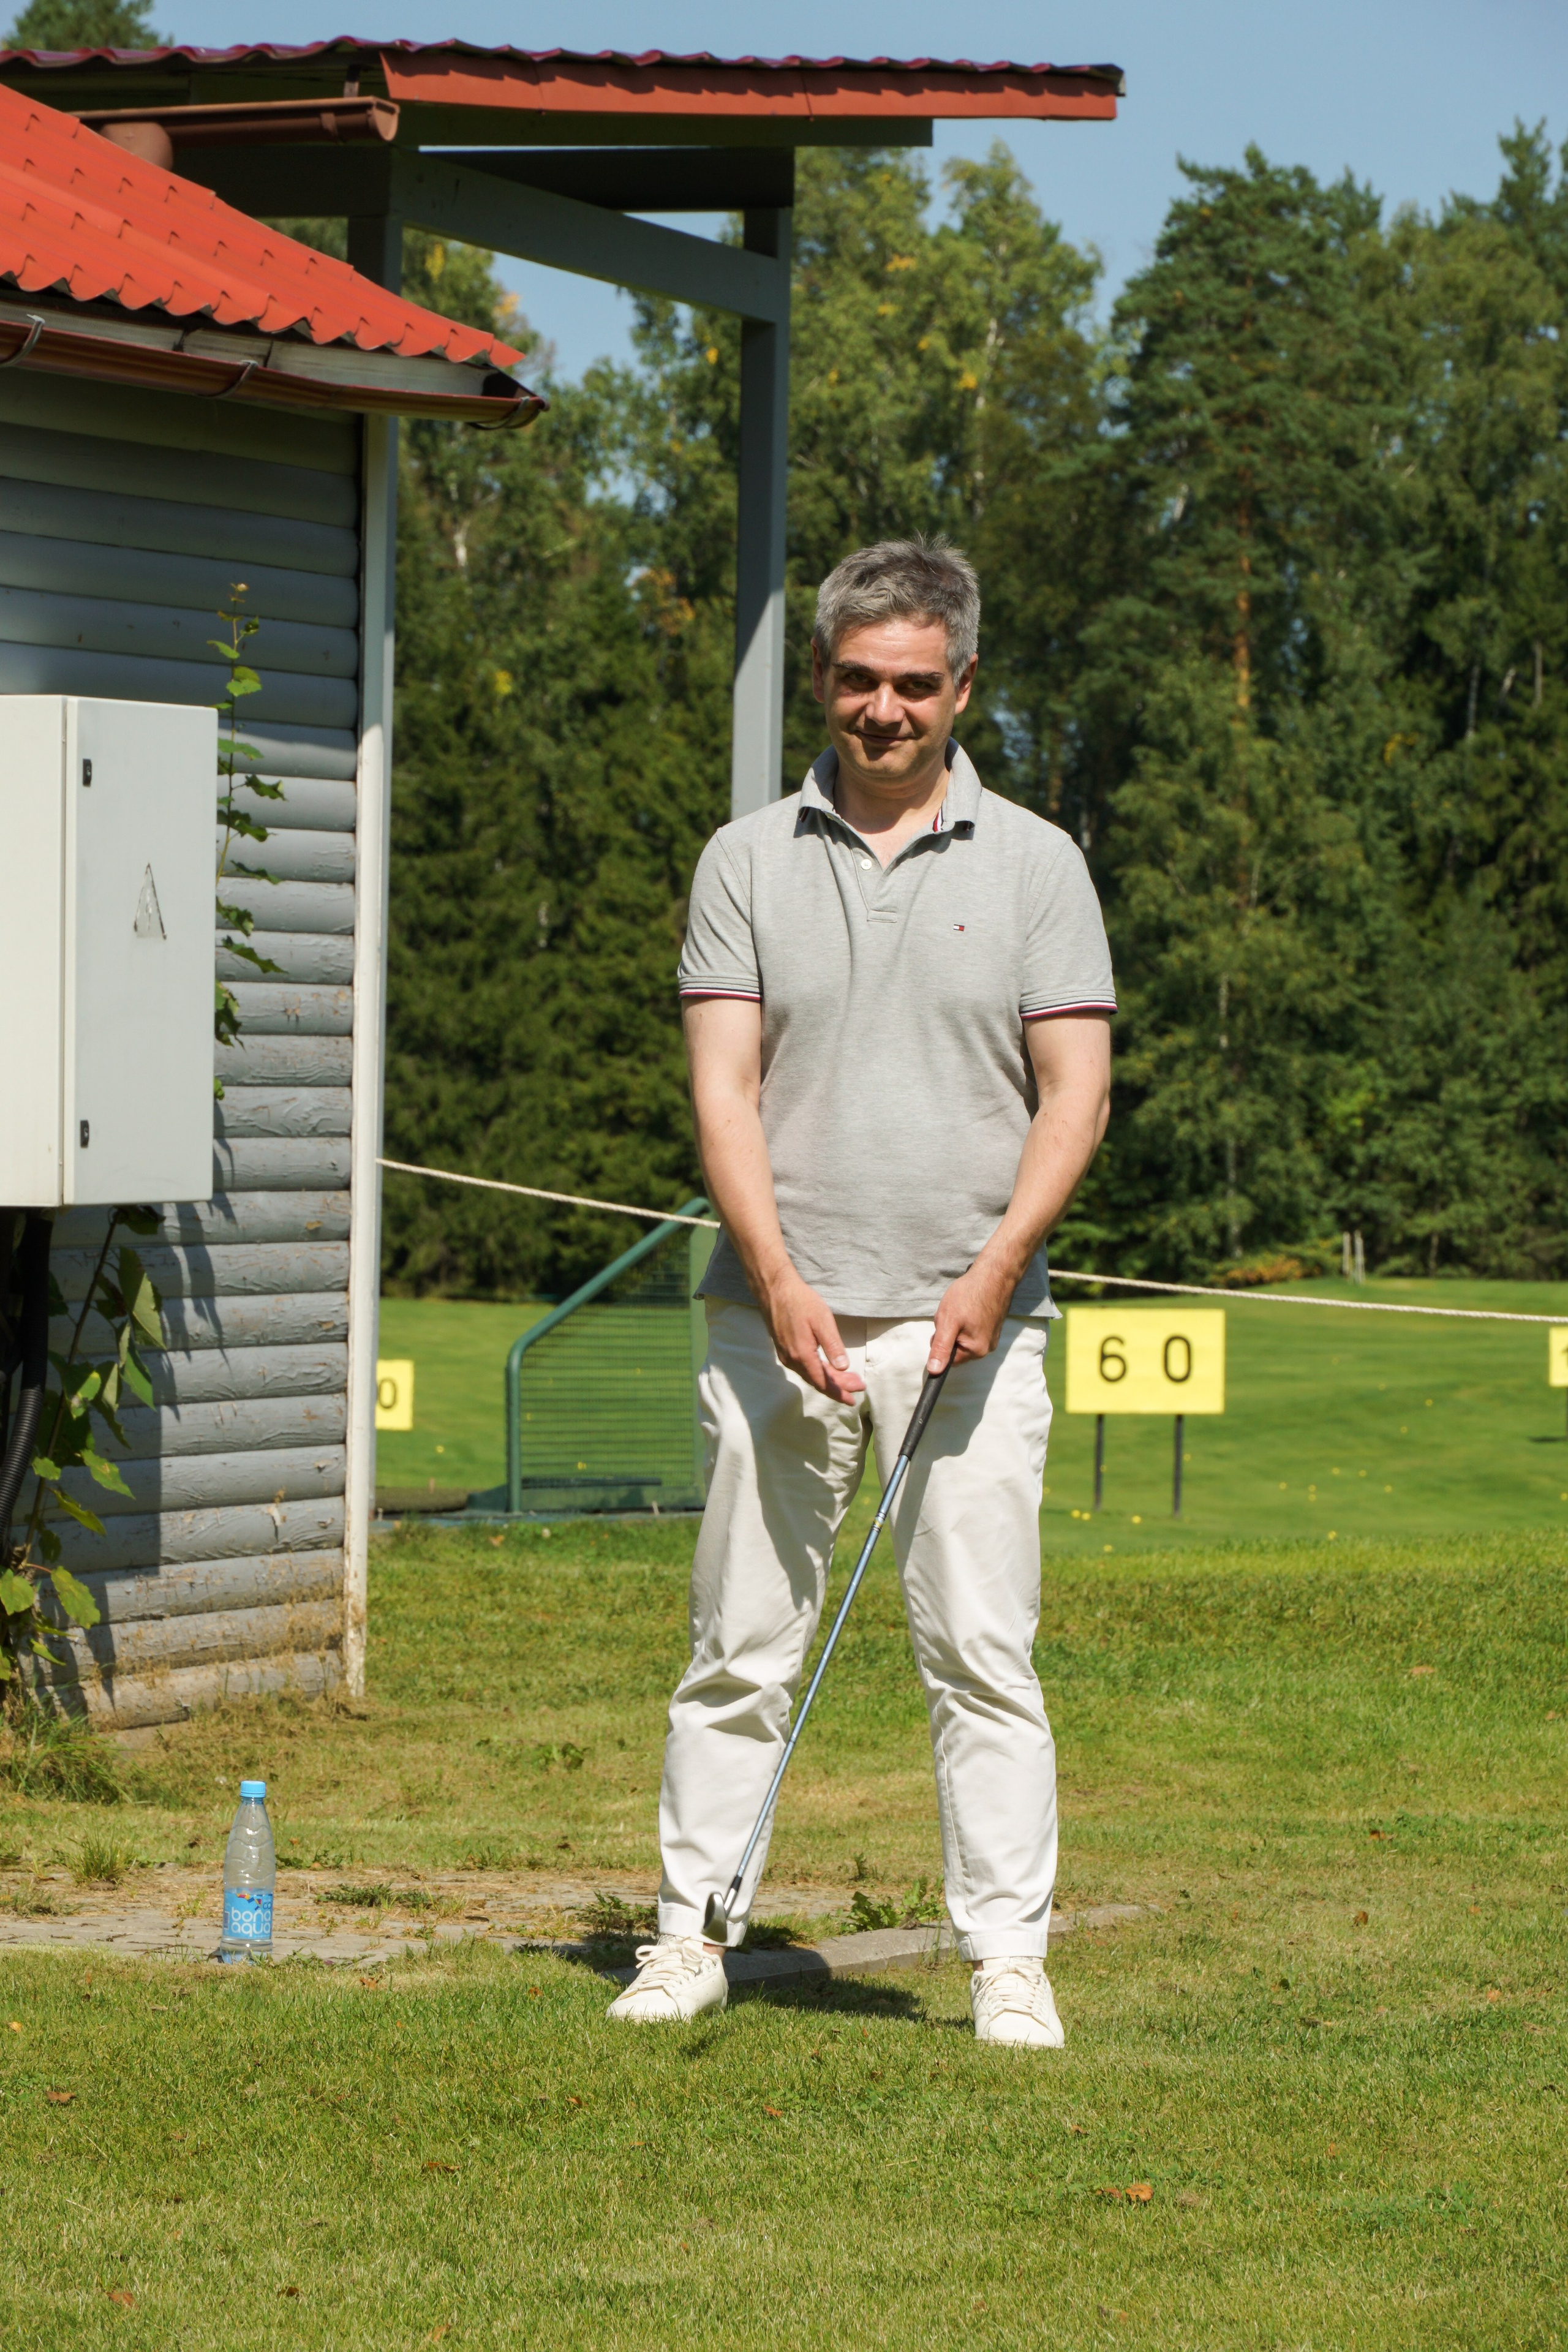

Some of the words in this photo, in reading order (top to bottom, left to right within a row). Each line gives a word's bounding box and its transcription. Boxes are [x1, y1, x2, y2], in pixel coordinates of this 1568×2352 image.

[1099, 1335, 1191, 1383] 60
[378, 1378, 397, 1409] 0
[231, 1921, 270, 1937] aqua
